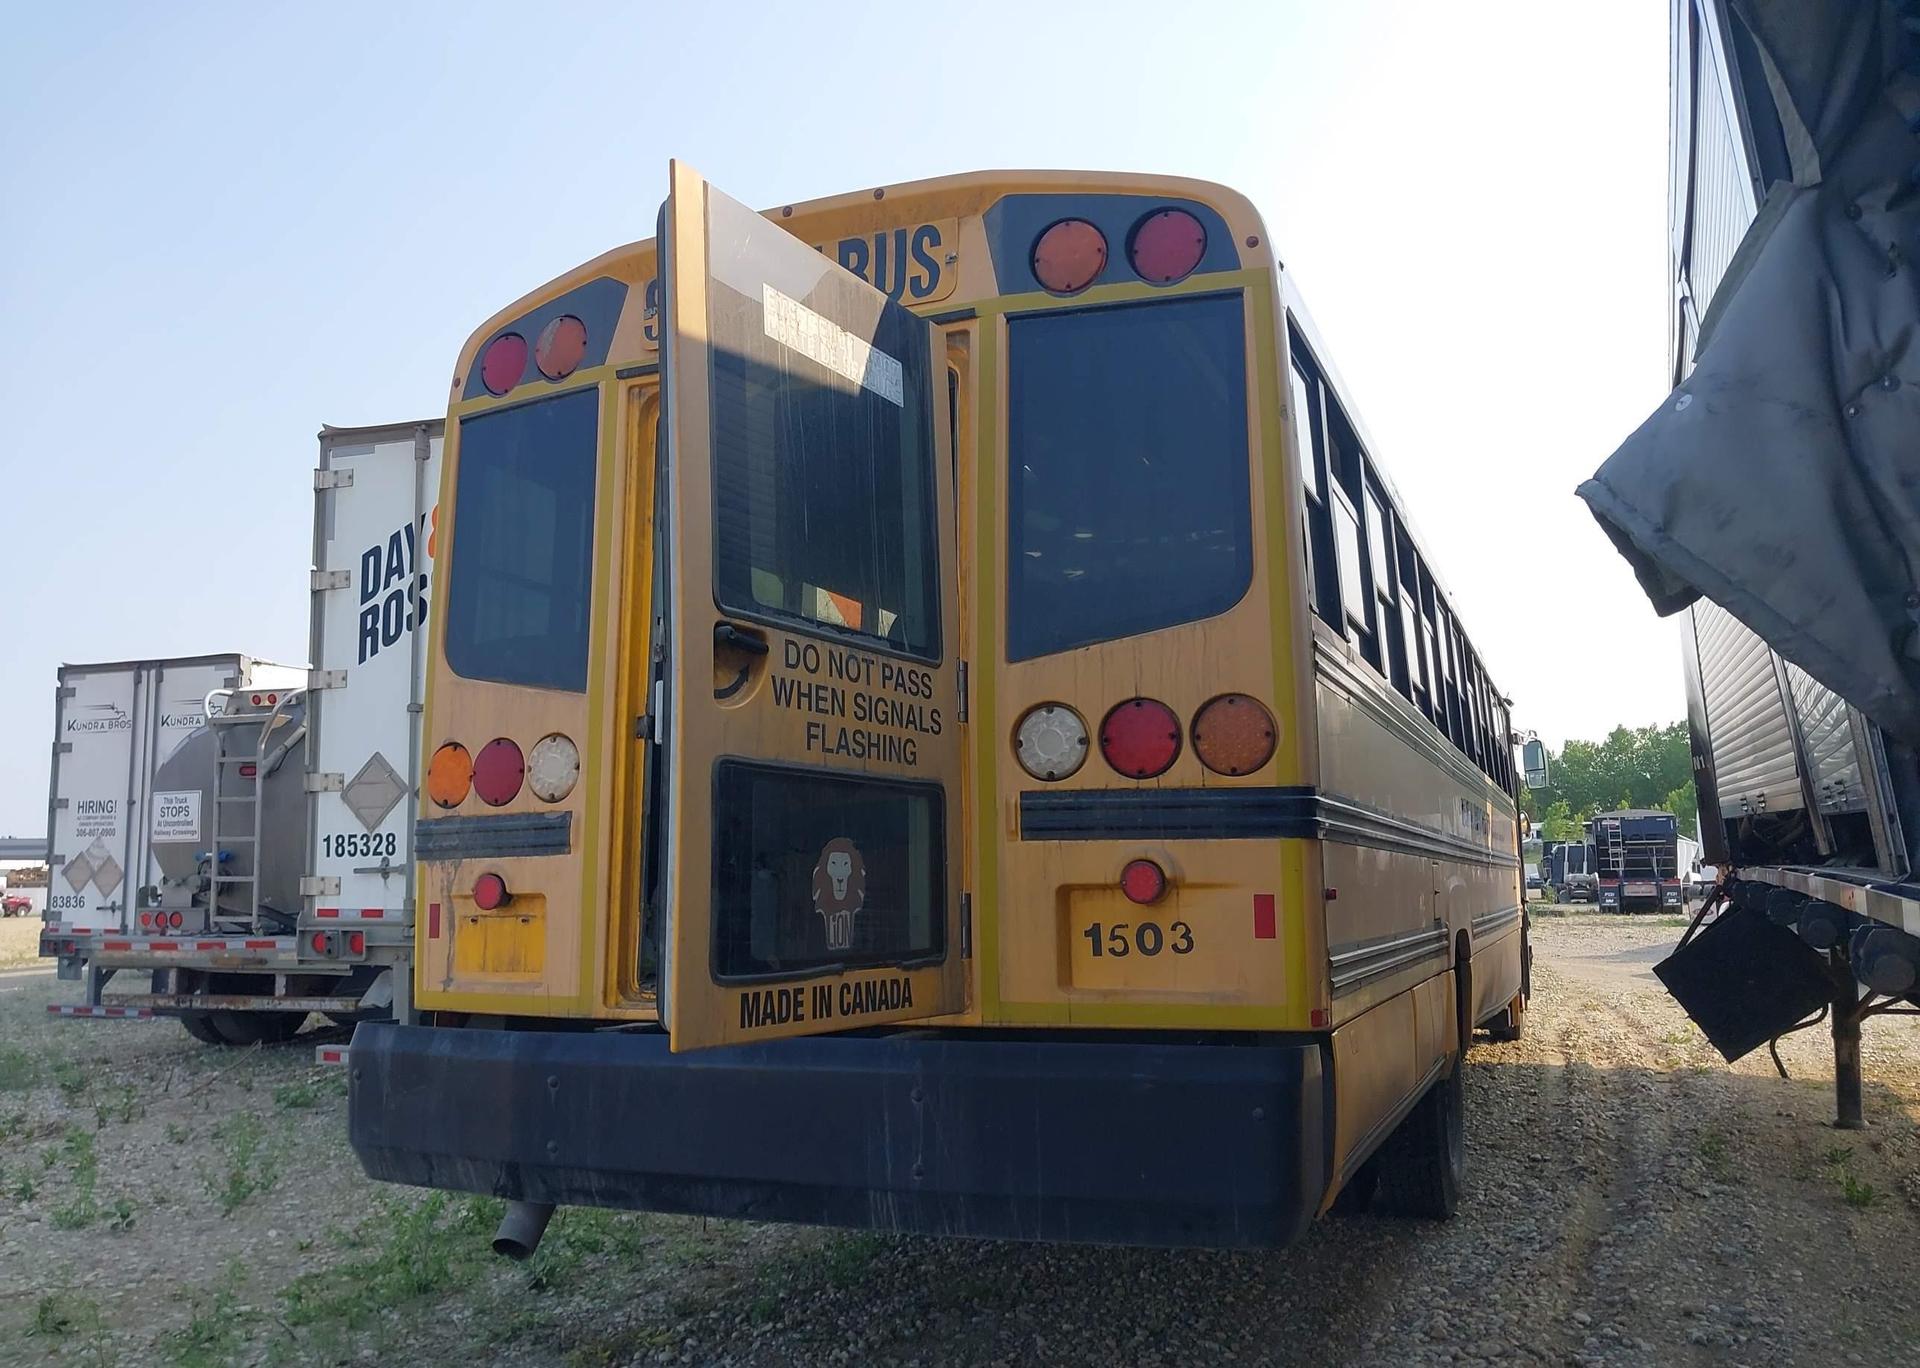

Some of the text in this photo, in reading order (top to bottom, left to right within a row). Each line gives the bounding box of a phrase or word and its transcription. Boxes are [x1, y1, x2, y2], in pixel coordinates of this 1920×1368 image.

[838, 224, 942, 303] BUS
[784, 638, 933, 700] DO NOT PASS
[771, 674, 942, 736] WHEN SIGNALS
[67, 719, 132, 732] KUNDRA BROS
[161, 714, 201, 727] KUNDRA
[806, 721, 917, 766] FLASHING
[77, 800, 118, 814] HIRING!
[160, 805, 190, 818] STOPS
[175, 796, 188, 804] Truck
[323, 832, 396, 858] 185328
[52, 895, 85, 909] 83836
[1083, 920, 1195, 957] 1503
[740, 977, 913, 1029] MADE IN CANADA
